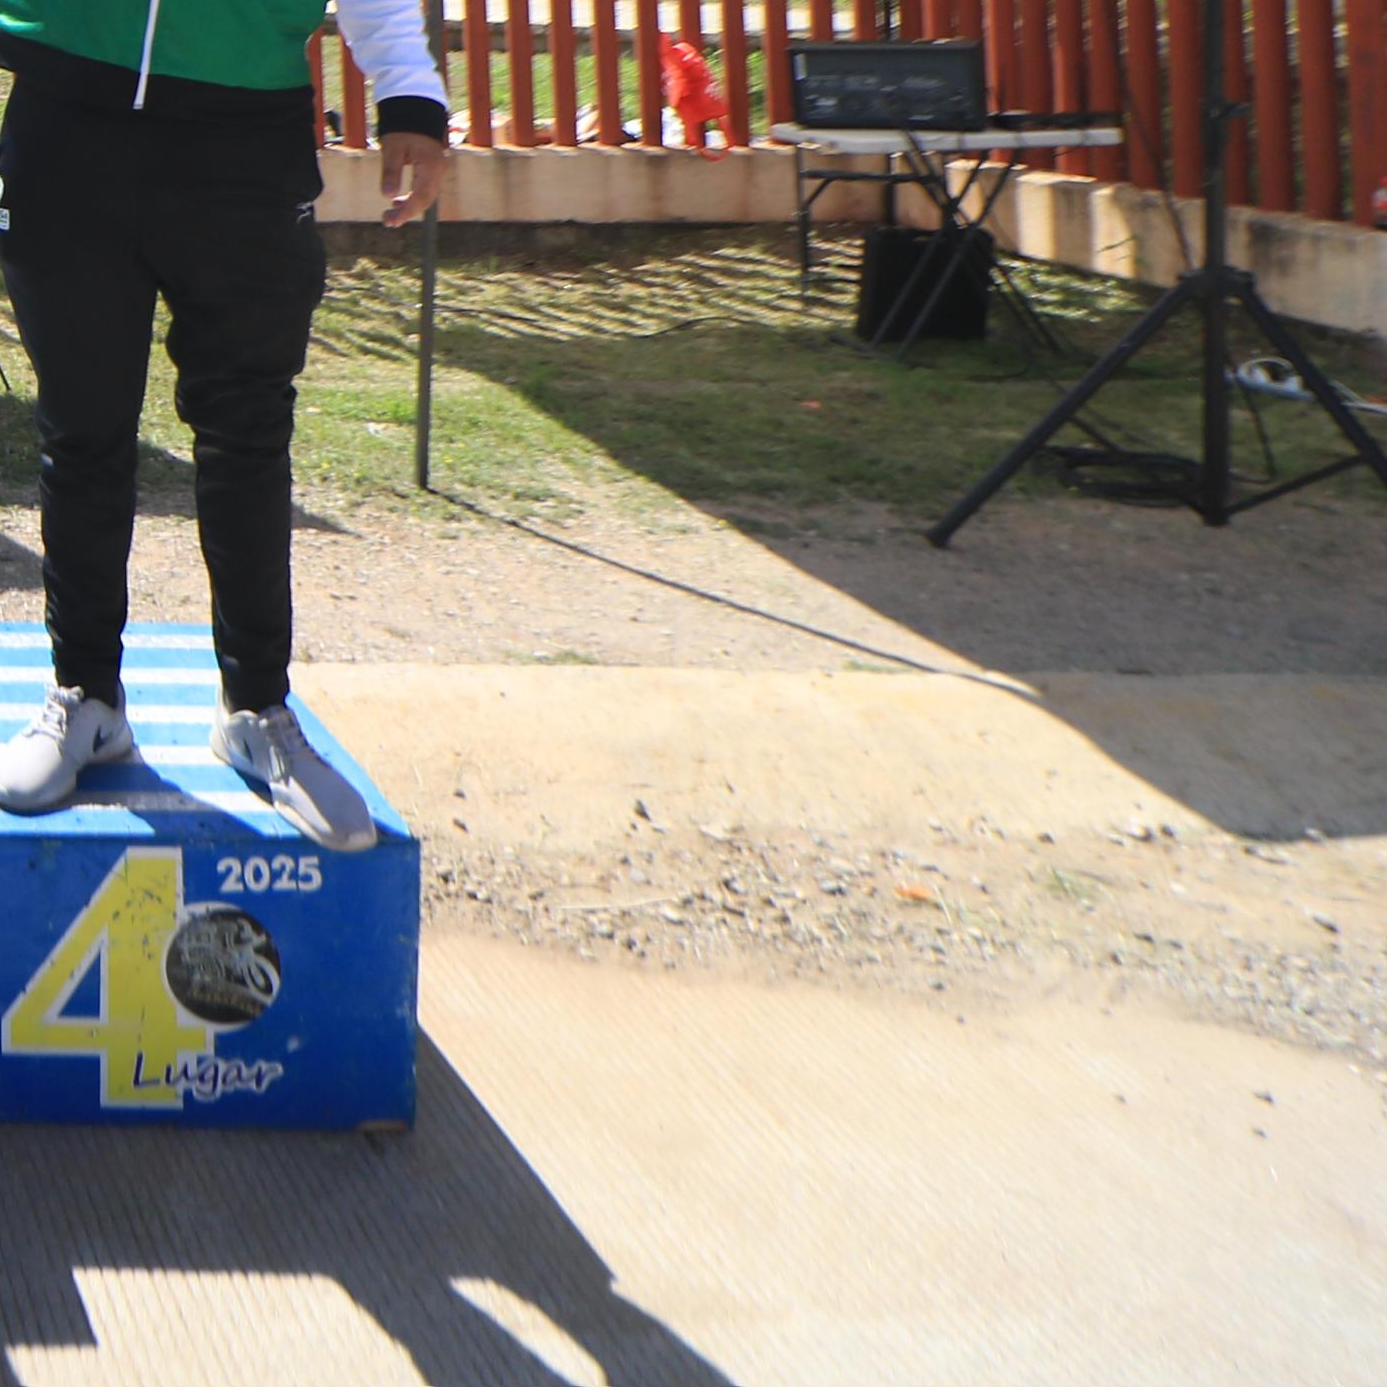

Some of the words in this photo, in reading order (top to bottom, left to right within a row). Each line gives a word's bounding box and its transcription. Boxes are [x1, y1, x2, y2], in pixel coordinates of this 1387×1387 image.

[217, 854, 323, 893] 2025
[1, 845, 215, 1110] 4
[133, 1052, 284, 1102] Lugar
